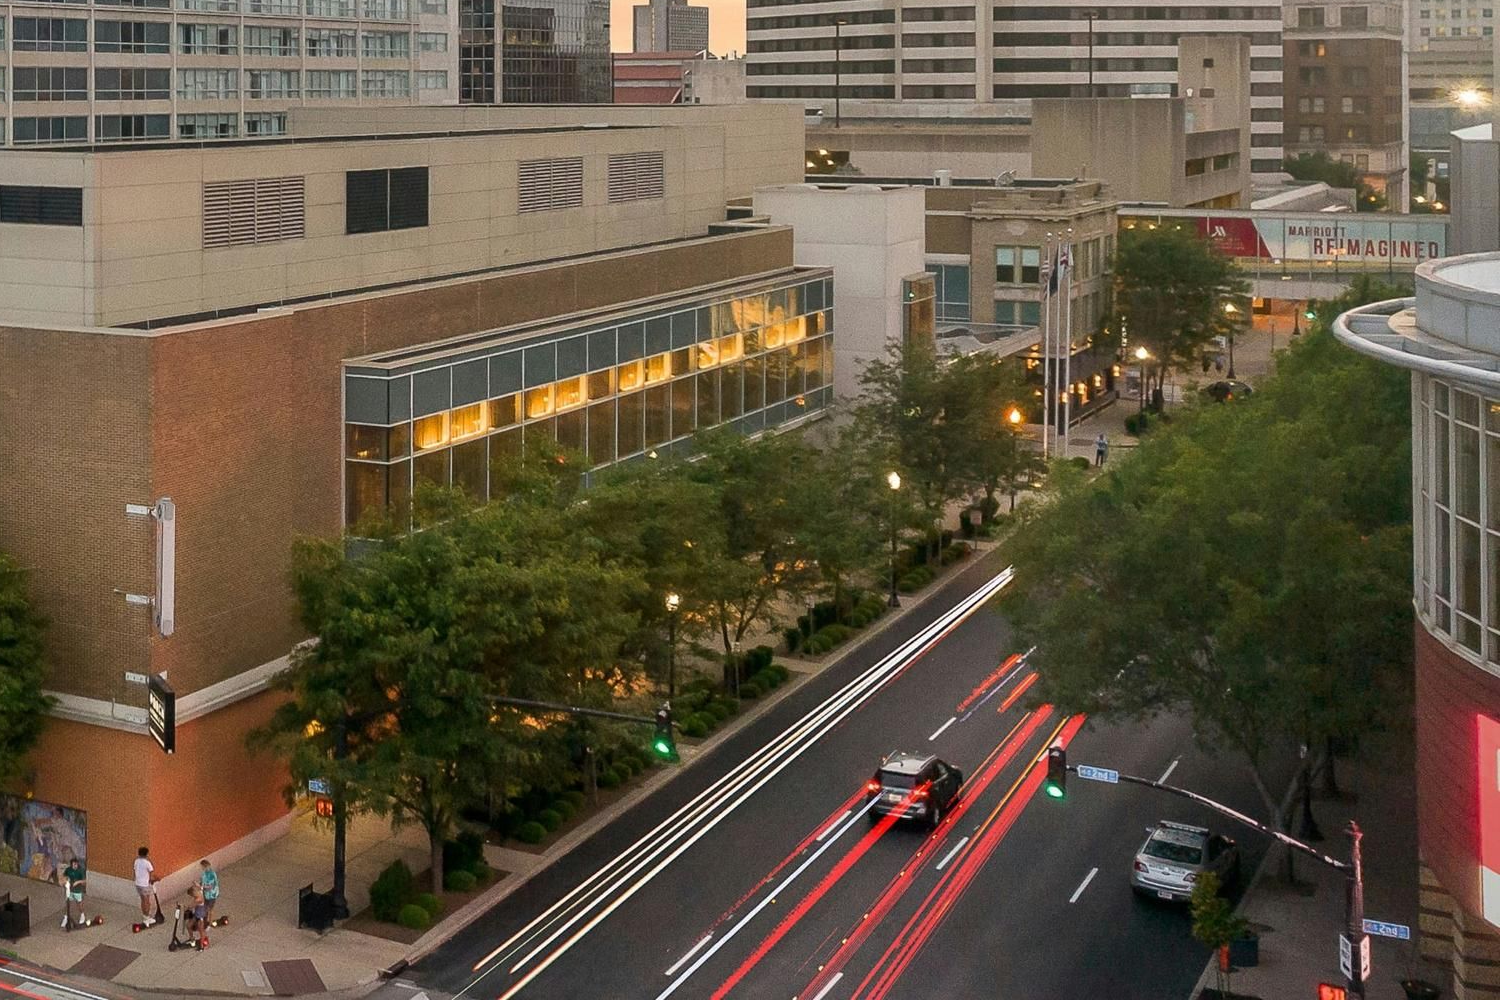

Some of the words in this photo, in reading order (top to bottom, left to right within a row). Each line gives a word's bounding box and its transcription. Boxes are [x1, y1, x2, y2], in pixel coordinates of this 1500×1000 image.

[1288, 226, 1346, 237] MARRIOTT
[1314, 238, 1439, 258] REIMAGINED
[1380, 925, 1398, 936] 2nd
